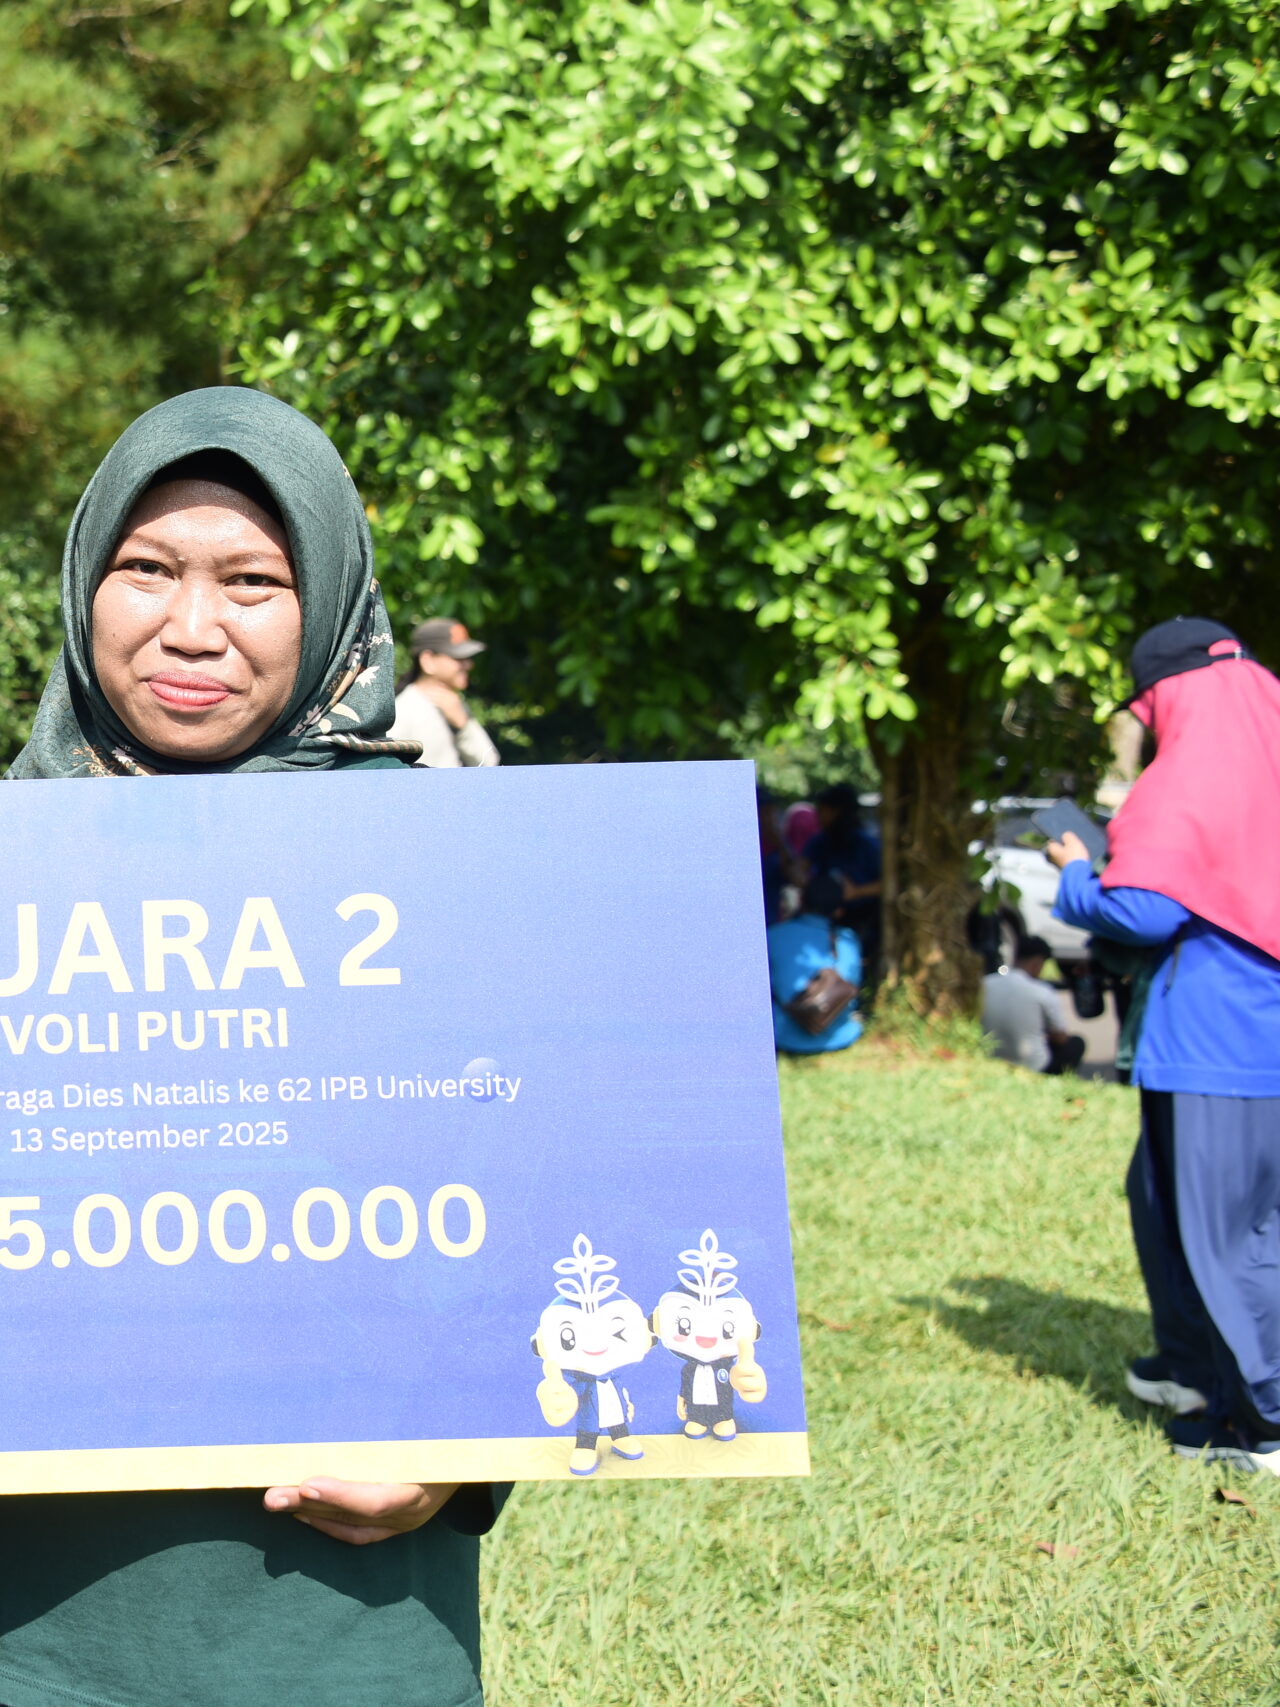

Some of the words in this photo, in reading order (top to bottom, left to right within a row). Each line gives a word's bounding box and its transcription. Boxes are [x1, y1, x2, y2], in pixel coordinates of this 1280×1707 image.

[335, 892, 402, 987] 2
[0, 1012, 119, 1055] VOLI
[137, 1007, 289, 1052] PUTRI
[63, 1083, 124, 1108] Dies
[132, 1079, 230, 1106] Natalis
[239, 1078, 269, 1103] ke
[277, 1077, 312, 1102] 62
[321, 1076, 368, 1101] IPB
[377, 1071, 522, 1102] University
[11, 1127, 43, 1153] 13
[51, 1123, 211, 1157] September
[218, 1120, 289, 1147] 2025
